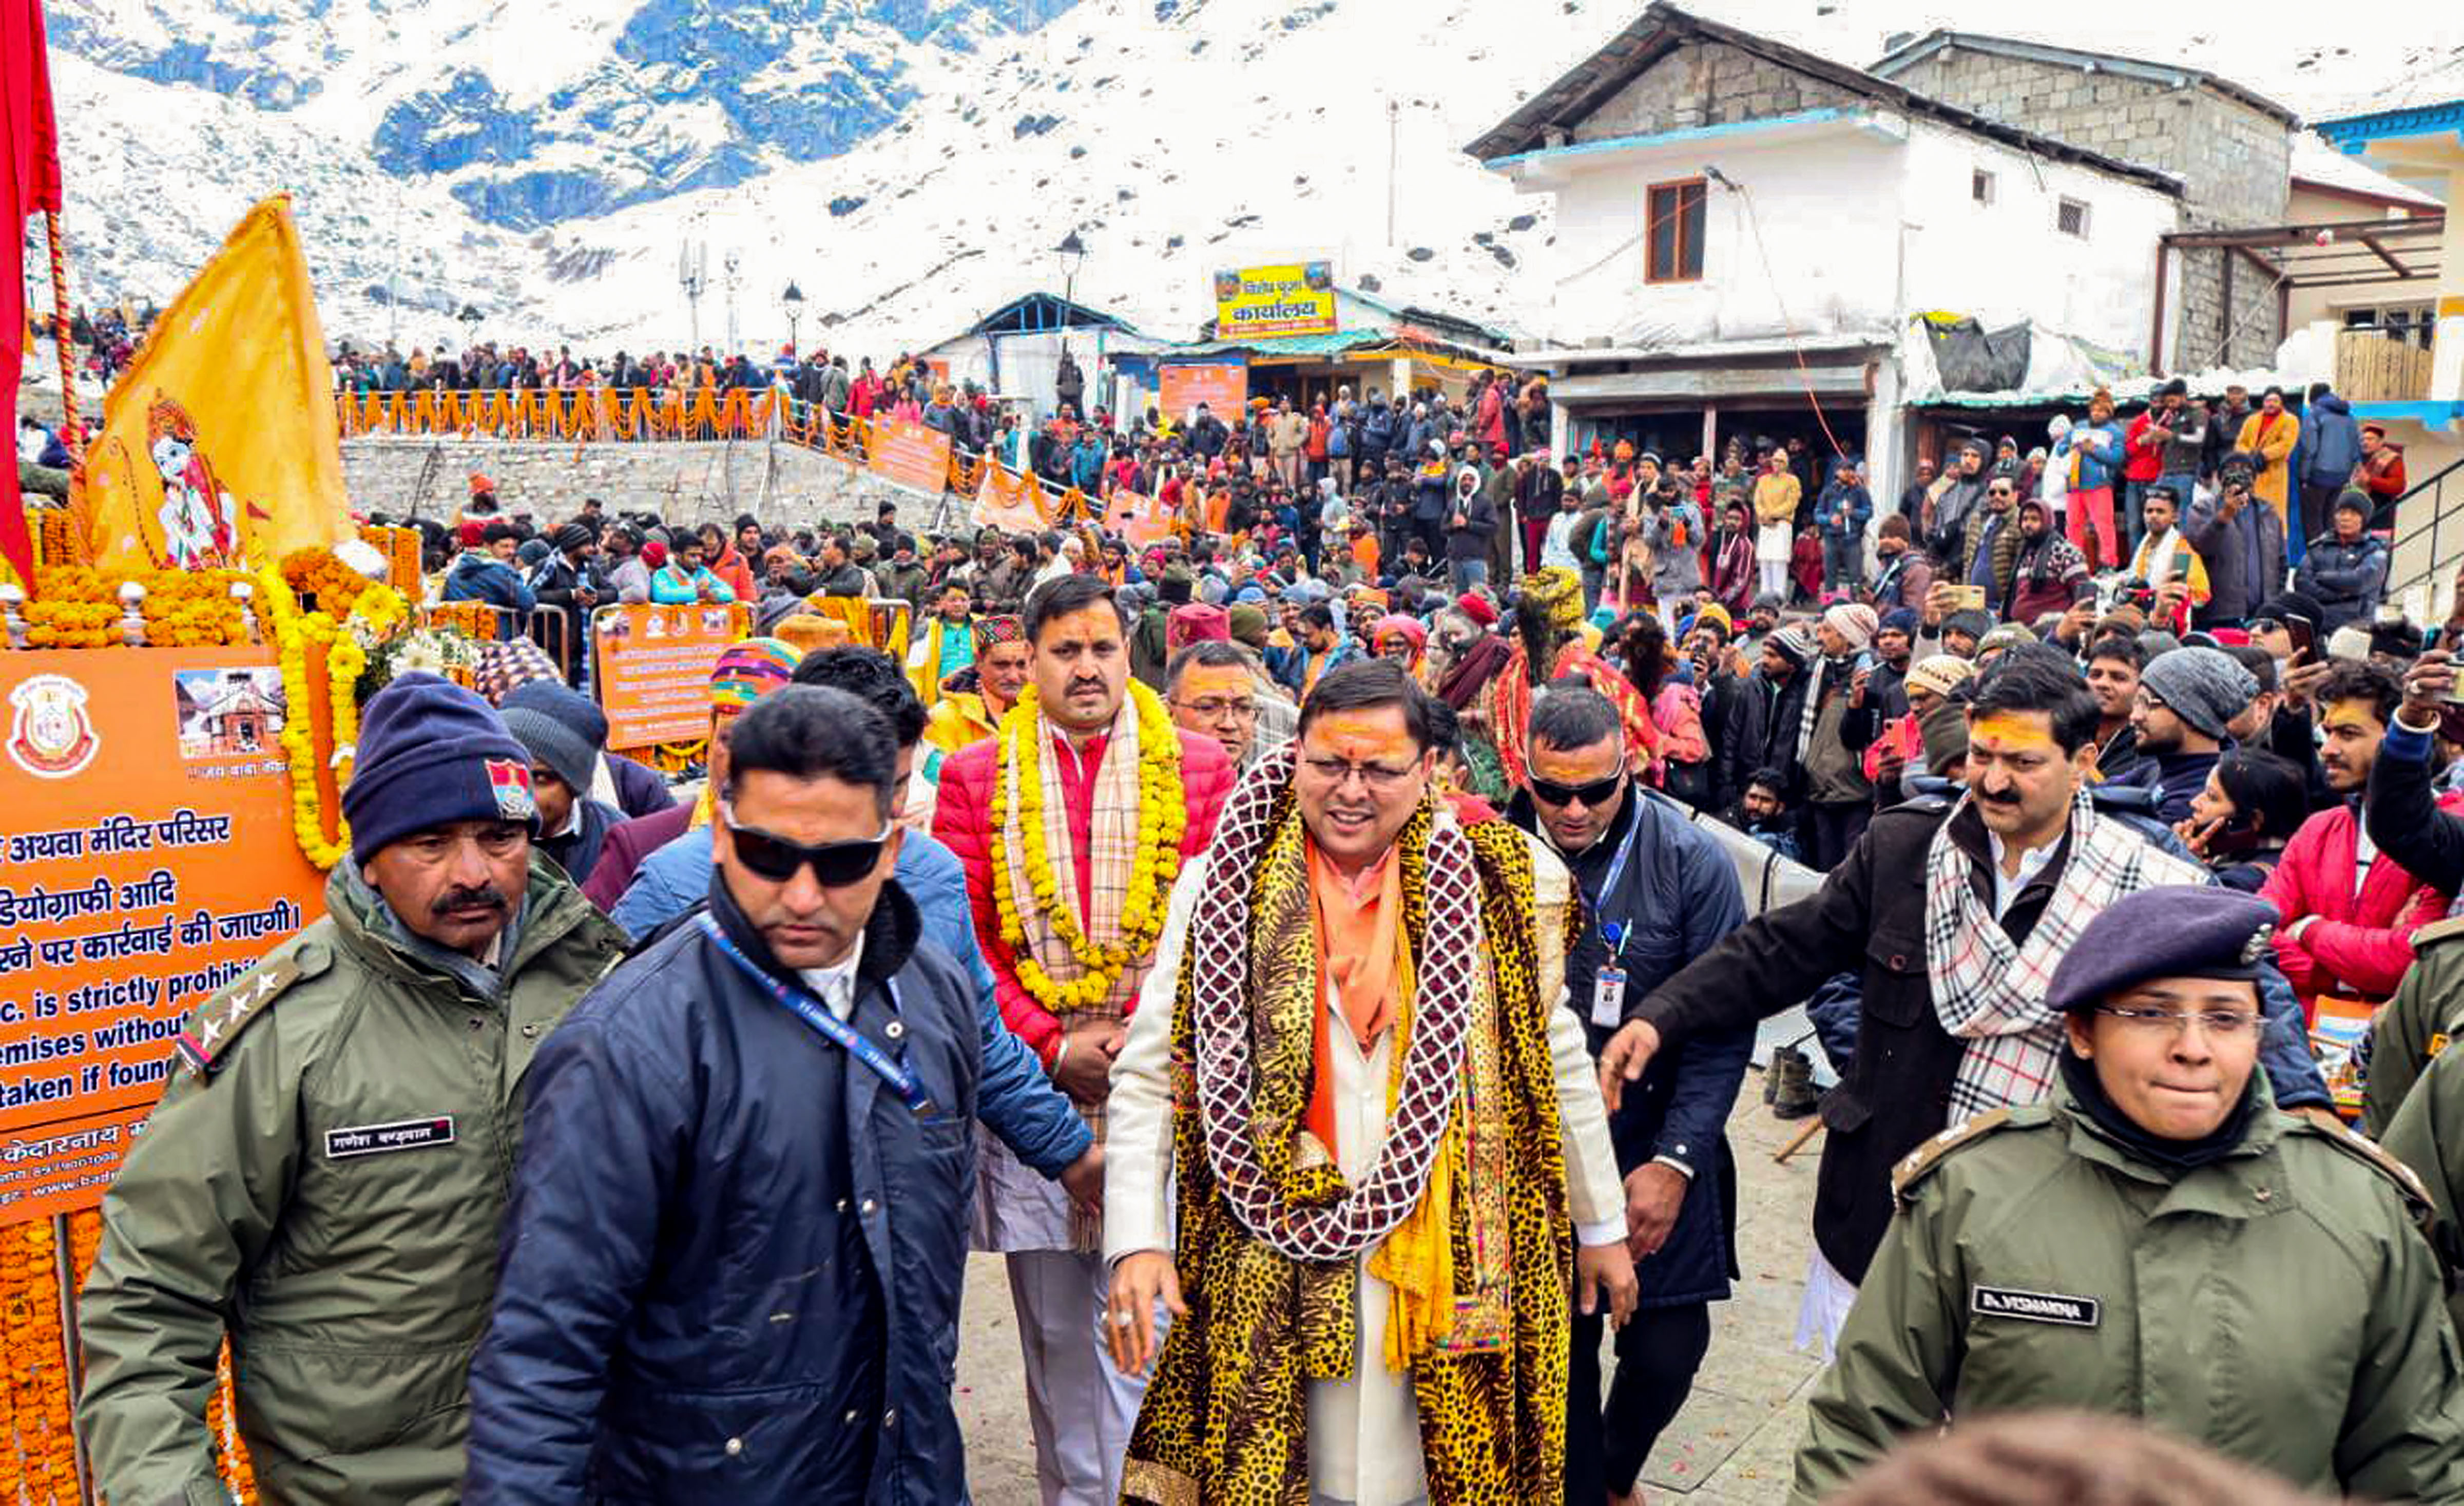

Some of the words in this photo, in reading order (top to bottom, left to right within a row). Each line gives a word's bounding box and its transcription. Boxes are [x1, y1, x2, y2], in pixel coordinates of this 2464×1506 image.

[1232, 299, 1317, 320] कार्यालय
[9, 831, 83, 863] अथवा
[89, 816, 153, 853] मंदिर
[157, 809, 229, 846] परिसर
[120, 870, 176, 910] आदि
[40, 938, 76, 965] पर
[82, 916, 173, 960] कार्रवाई
[180, 910, 213, 945] की
[218, 900, 301, 939] जाएगी।
[35, 991, 57, 1018] is
[67, 975, 160, 1014] strictly
[168, 958, 258, 1003] prohib
[81, 1064, 100, 1094] if
[108, 1058, 171, 1088] foun
